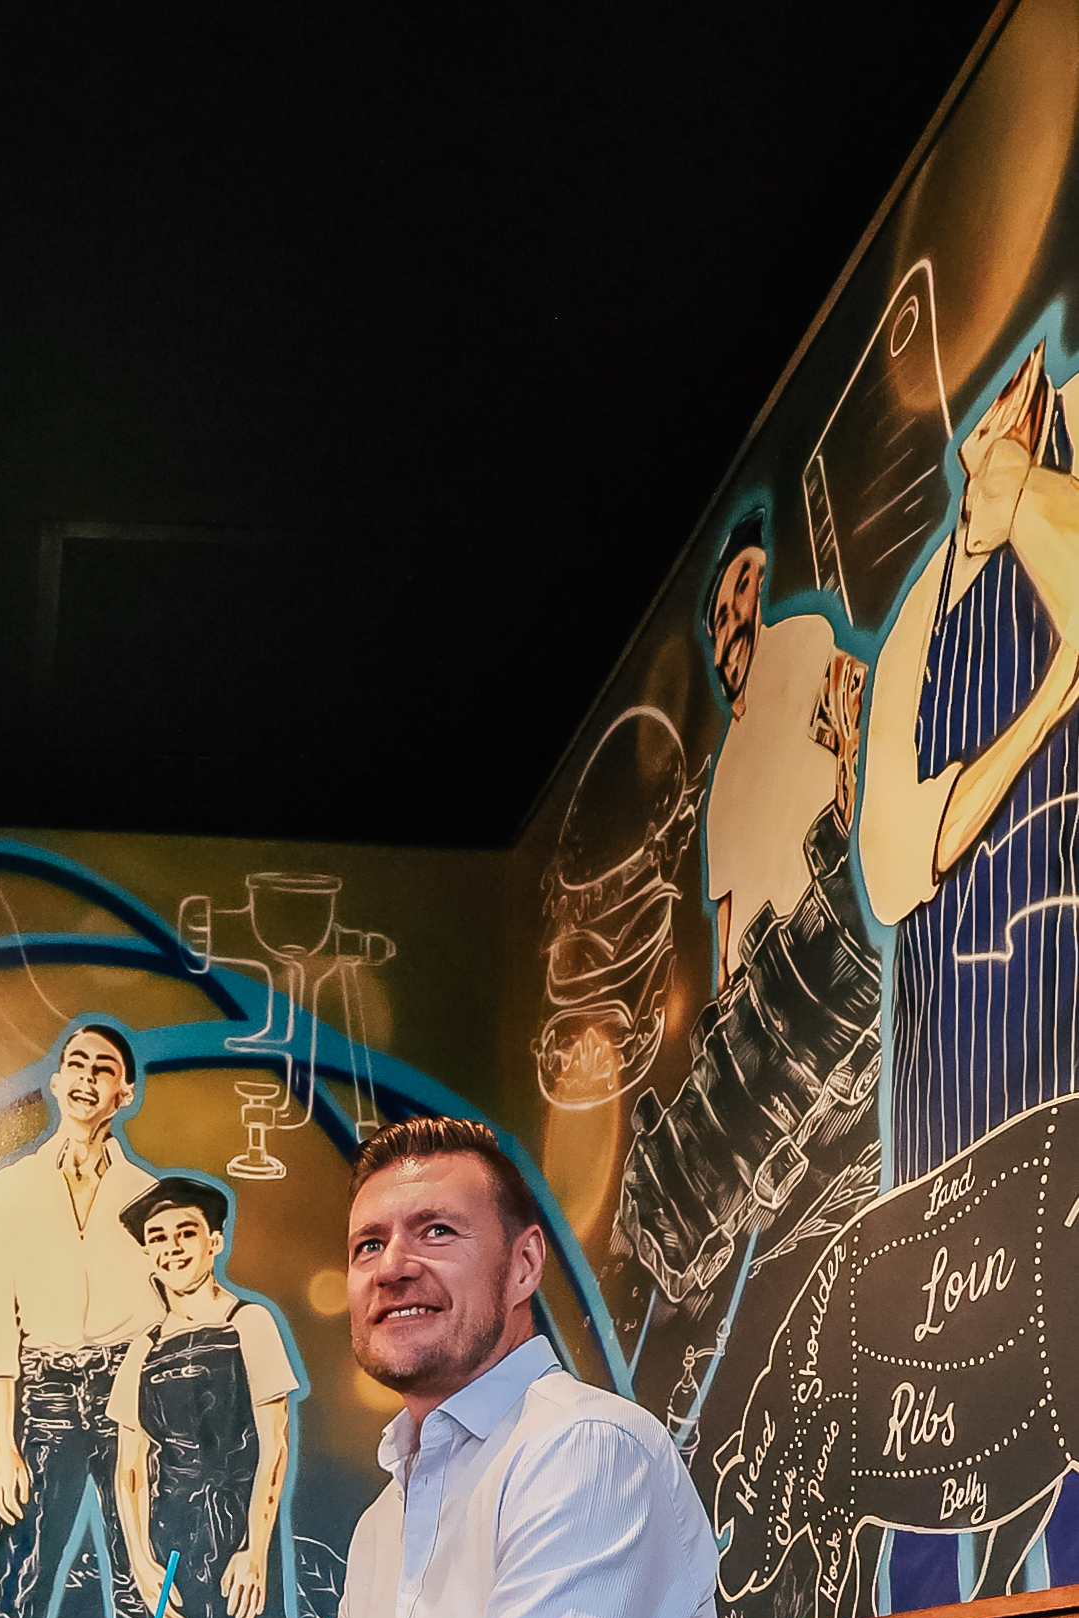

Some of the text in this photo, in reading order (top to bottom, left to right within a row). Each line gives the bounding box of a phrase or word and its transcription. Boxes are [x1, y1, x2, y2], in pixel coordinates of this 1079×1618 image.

[923, 1157, 976, 1221] Lard
[797, 1242, 847, 1404] Shoulder
[914, 1236, 1017, 1342] Loin
[807, 1420, 840, 1503] Picnic
[882, 1381, 955, 1462] Ribs
[736, 1410, 775, 1515] Head
[939, 1471, 988, 1525] Belly
[775, 1466, 798, 1547] Cheek
[820, 1528, 842, 1604] Hock
